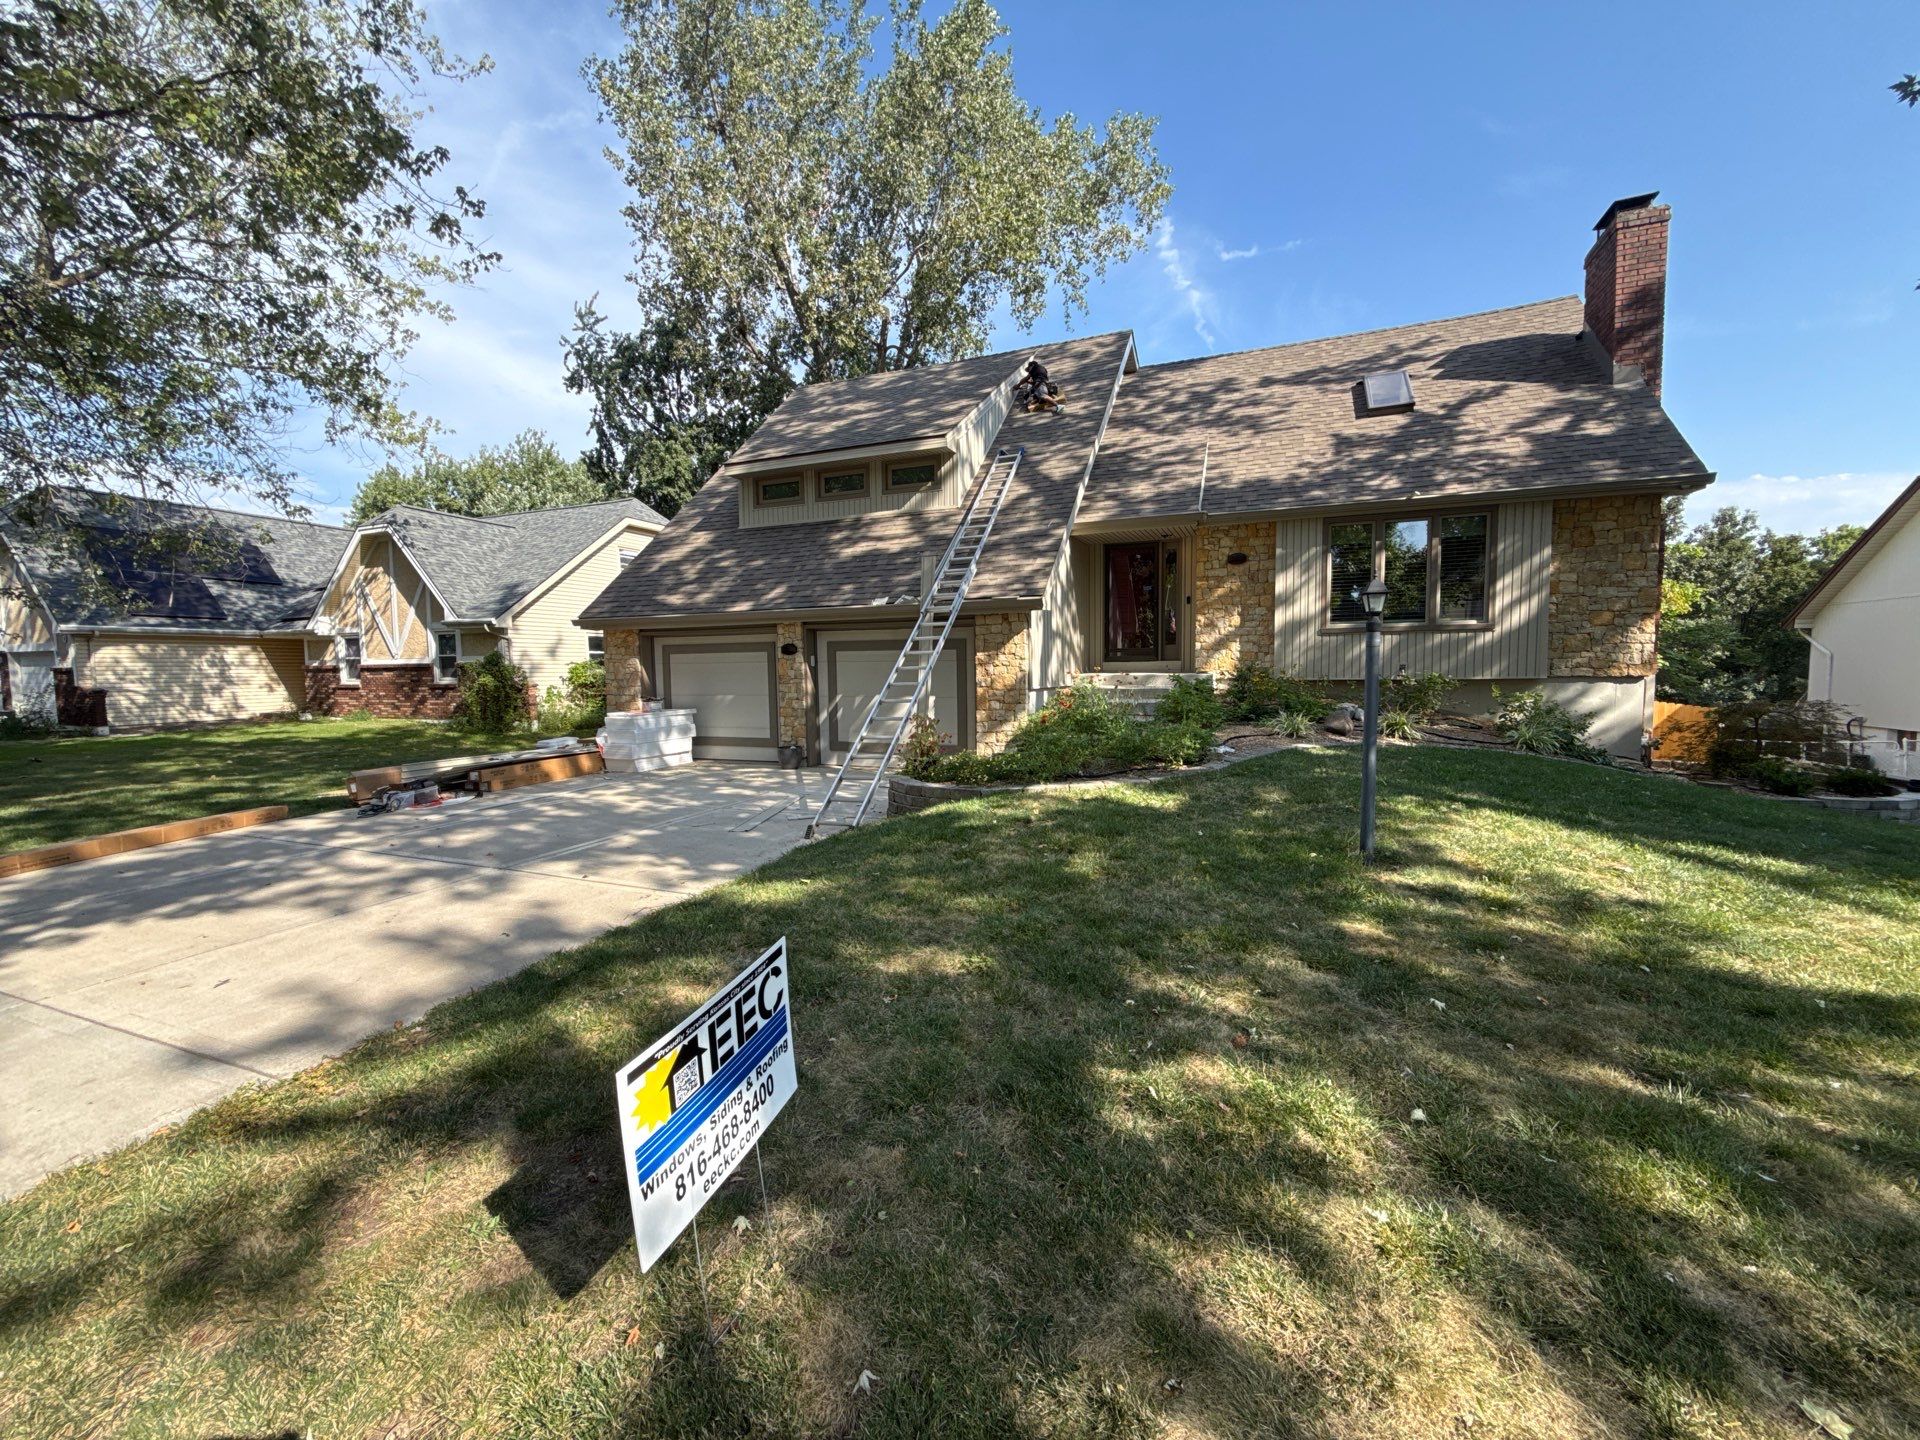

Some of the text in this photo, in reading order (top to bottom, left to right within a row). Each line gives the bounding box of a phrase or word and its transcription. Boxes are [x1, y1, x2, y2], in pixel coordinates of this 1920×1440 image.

[685, 1013, 709, 1036] Serving
[709, 995, 730, 1016] Kansas
[730, 986, 741, 998] City
[708, 966, 784, 1076] EEC
[641, 1037, 789, 1202] Windows, Siding & Roofing
[675, 1073, 775, 1202] 816-468-8400
[703, 1119, 760, 1194] eeckc.com
